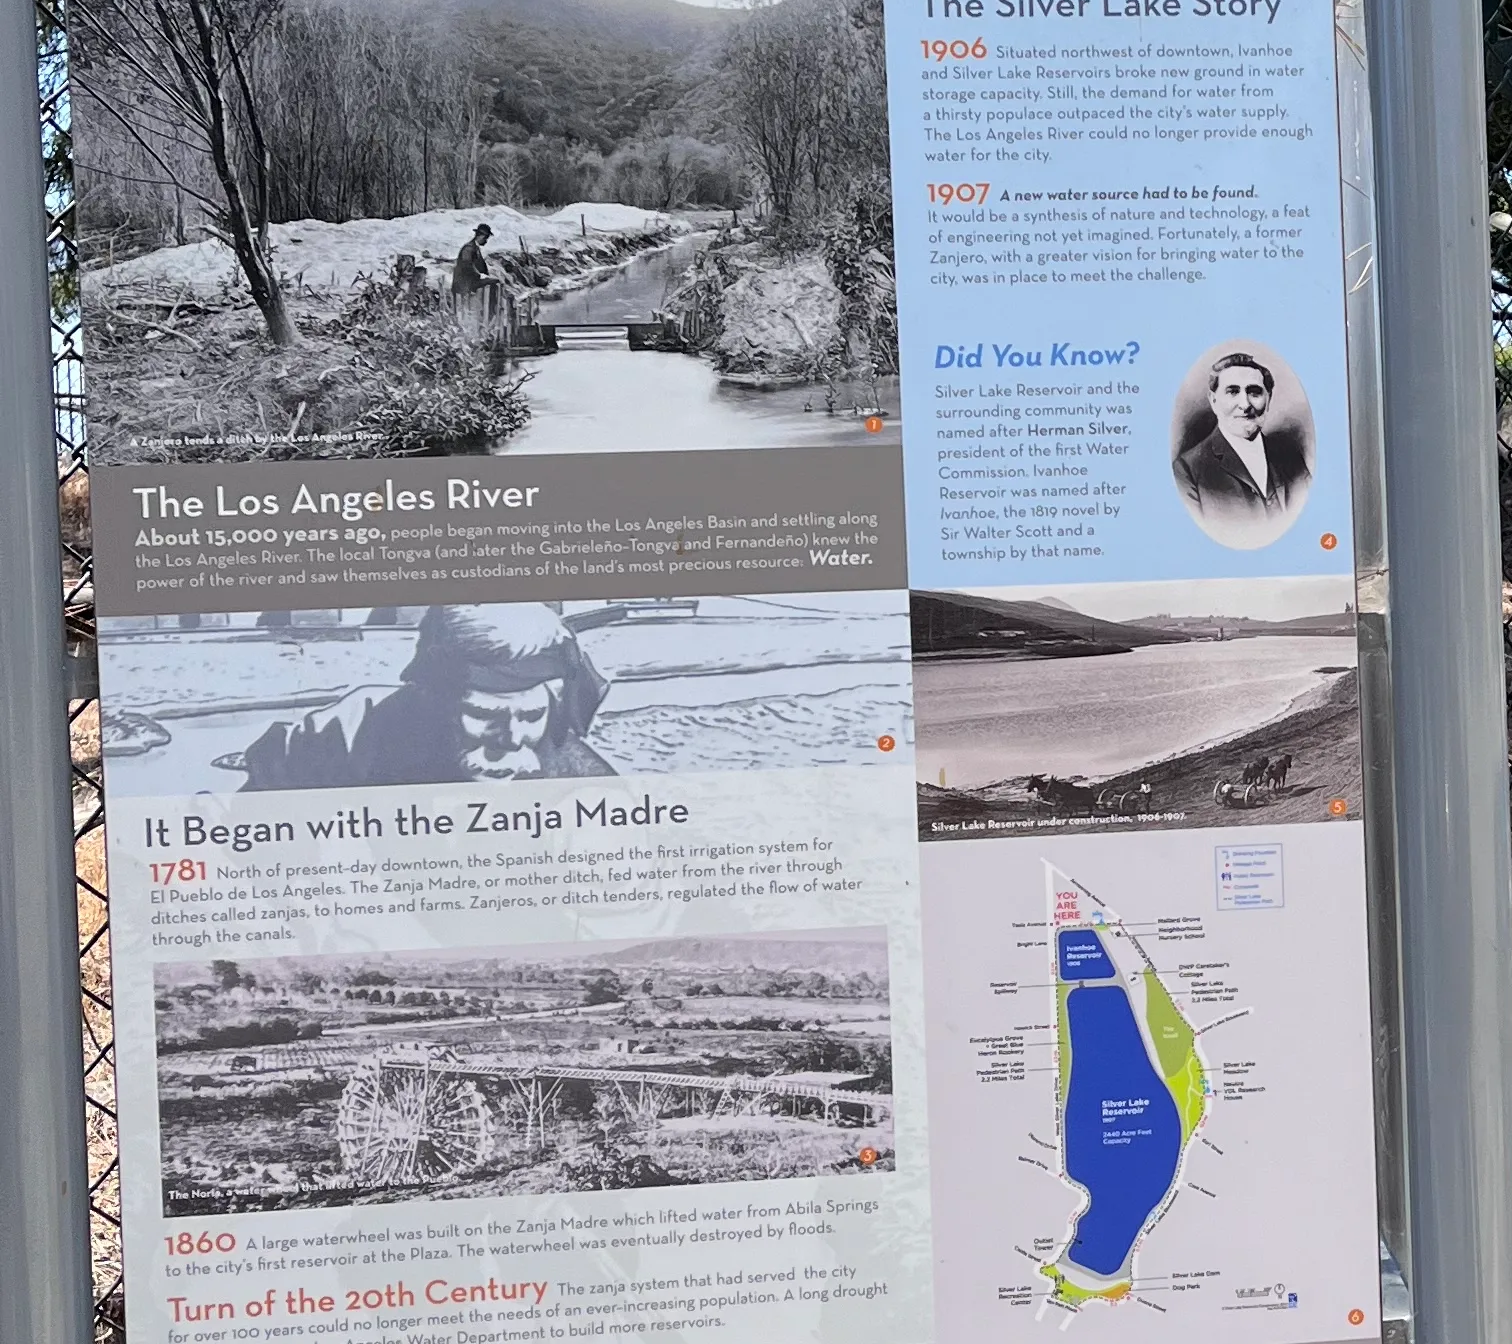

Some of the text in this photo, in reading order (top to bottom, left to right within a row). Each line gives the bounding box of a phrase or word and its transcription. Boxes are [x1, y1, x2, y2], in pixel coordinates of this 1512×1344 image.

[920, 37, 1292, 61] 1906 Situated northwest of downtown, Ivanhoe
[927, 183, 1257, 205] 1907 A new water source had to be found.
[935, 341, 1139, 368] Did You Know?
[132, 479, 539, 520] The Los Angeles River
[135, 519, 386, 547] About 15,000 years ago,
[146, 794, 688, 852] It Began with the Zanja Madre
[931, 823, 958, 832] Silver
[962, 821, 985, 830] Lake
[988, 819, 1035, 829] Reservoir
[1038, 817, 1065, 827] under
[149, 859, 206, 885] 1781
[1054, 911, 1081, 920] HERE
[1056, 901, 1077, 909] ARE
[163, 1231, 236, 1256] 1860
[167, 1277, 548, 1322] Turn of the 20th Century
